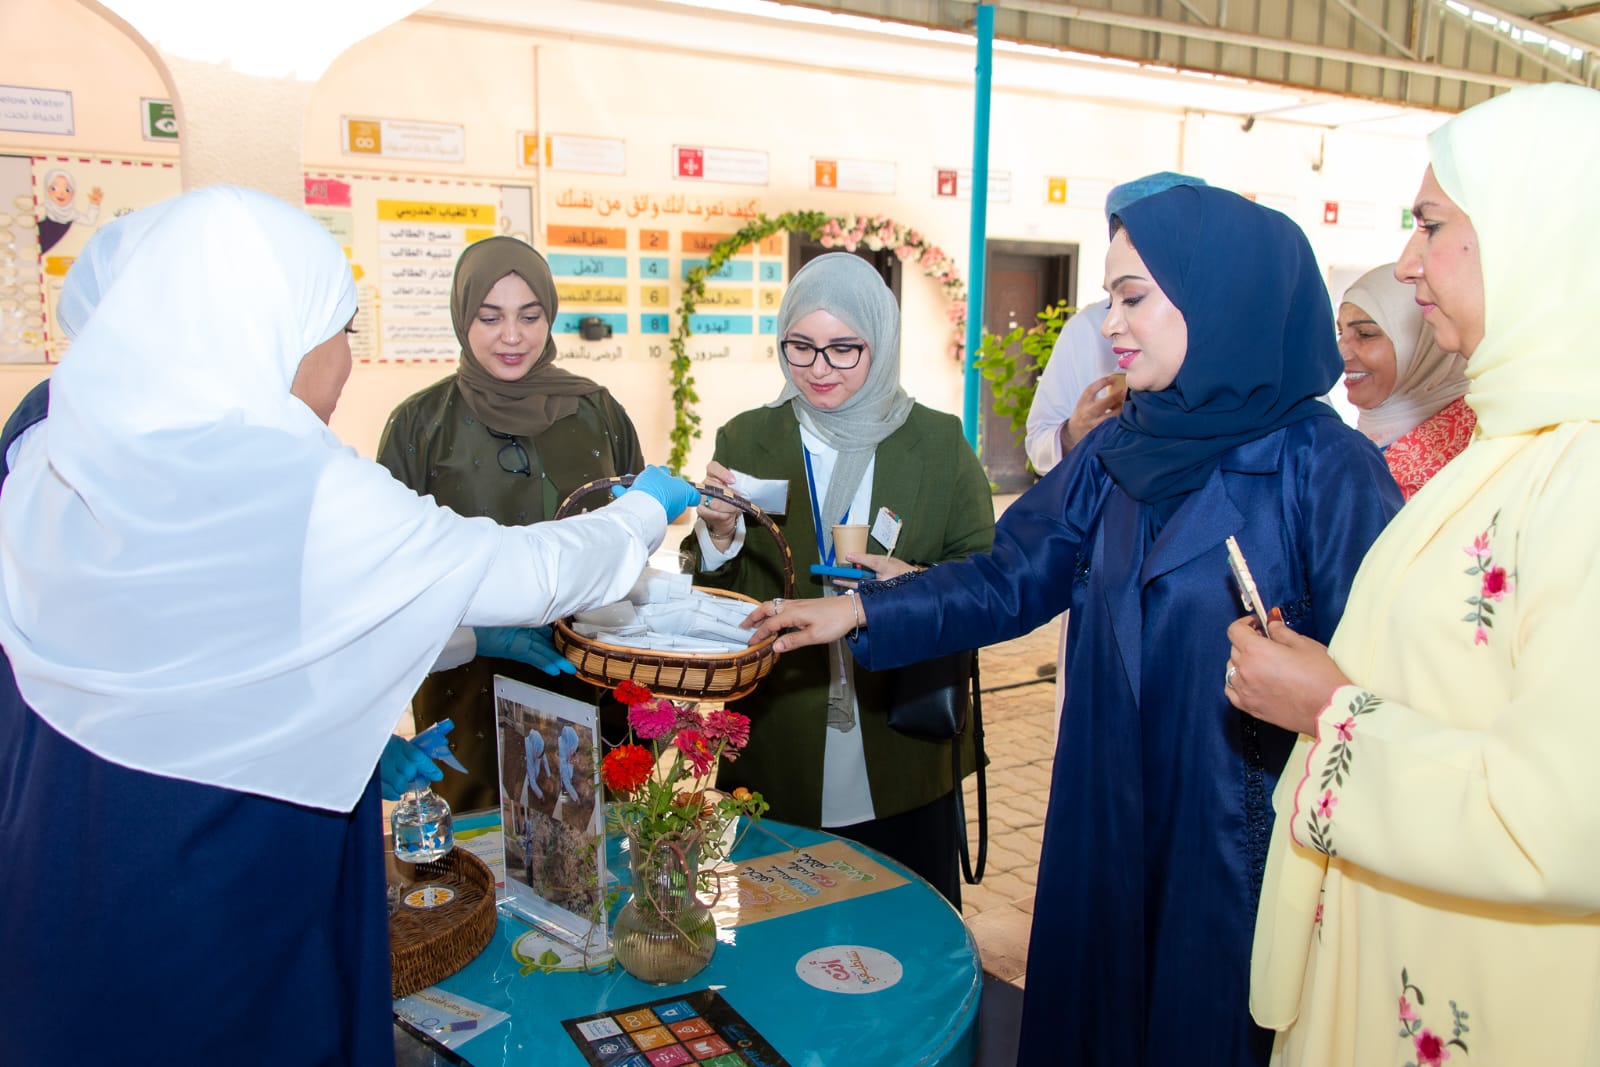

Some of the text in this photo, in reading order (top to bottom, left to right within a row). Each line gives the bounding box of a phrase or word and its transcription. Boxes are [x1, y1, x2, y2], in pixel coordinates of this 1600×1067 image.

[597, 196, 621, 217] من
[649, 232, 659, 248] 2
[650, 289, 659, 304] 6
[651, 318, 660, 331] 8
[766, 318, 774, 331] 7
[648, 345, 662, 359] 10
